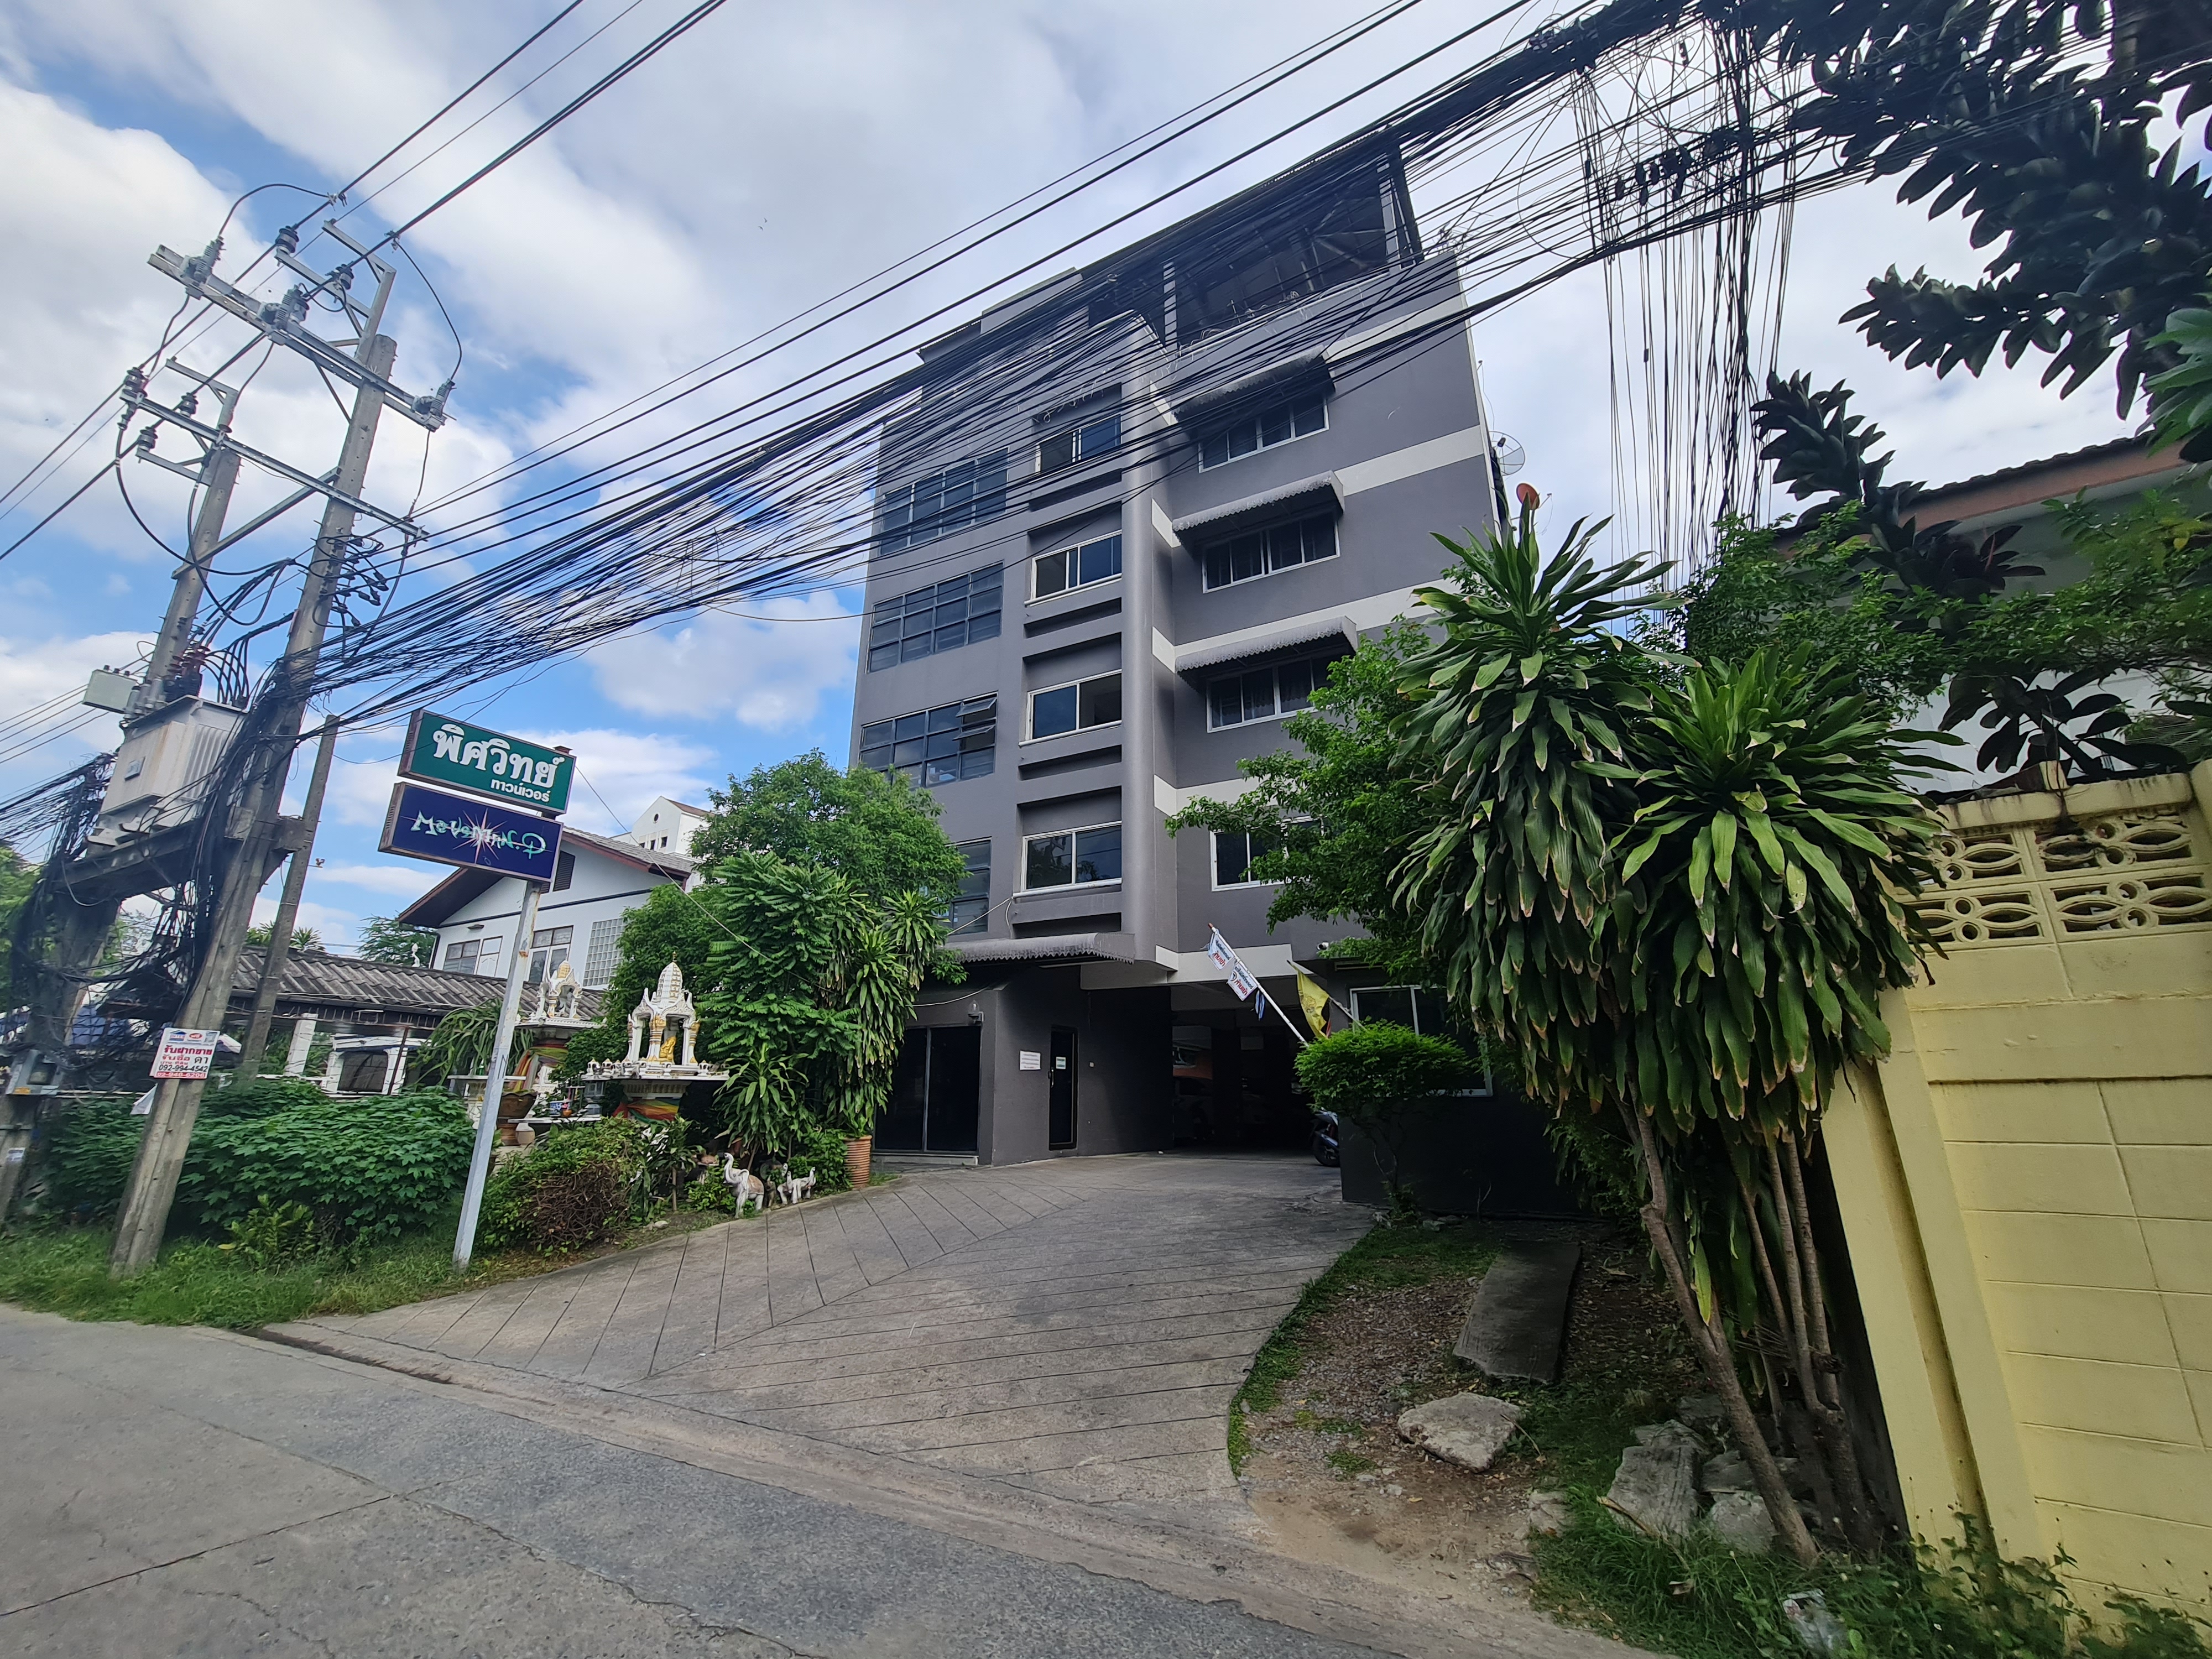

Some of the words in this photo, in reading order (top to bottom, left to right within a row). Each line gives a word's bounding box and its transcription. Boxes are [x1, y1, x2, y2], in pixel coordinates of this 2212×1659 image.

[433, 723, 565, 788] พิศวิทย์
[491, 779, 551, 802] ทาวน์เวอร์
[164, 1045, 213, 1055] รับฝากขาย
